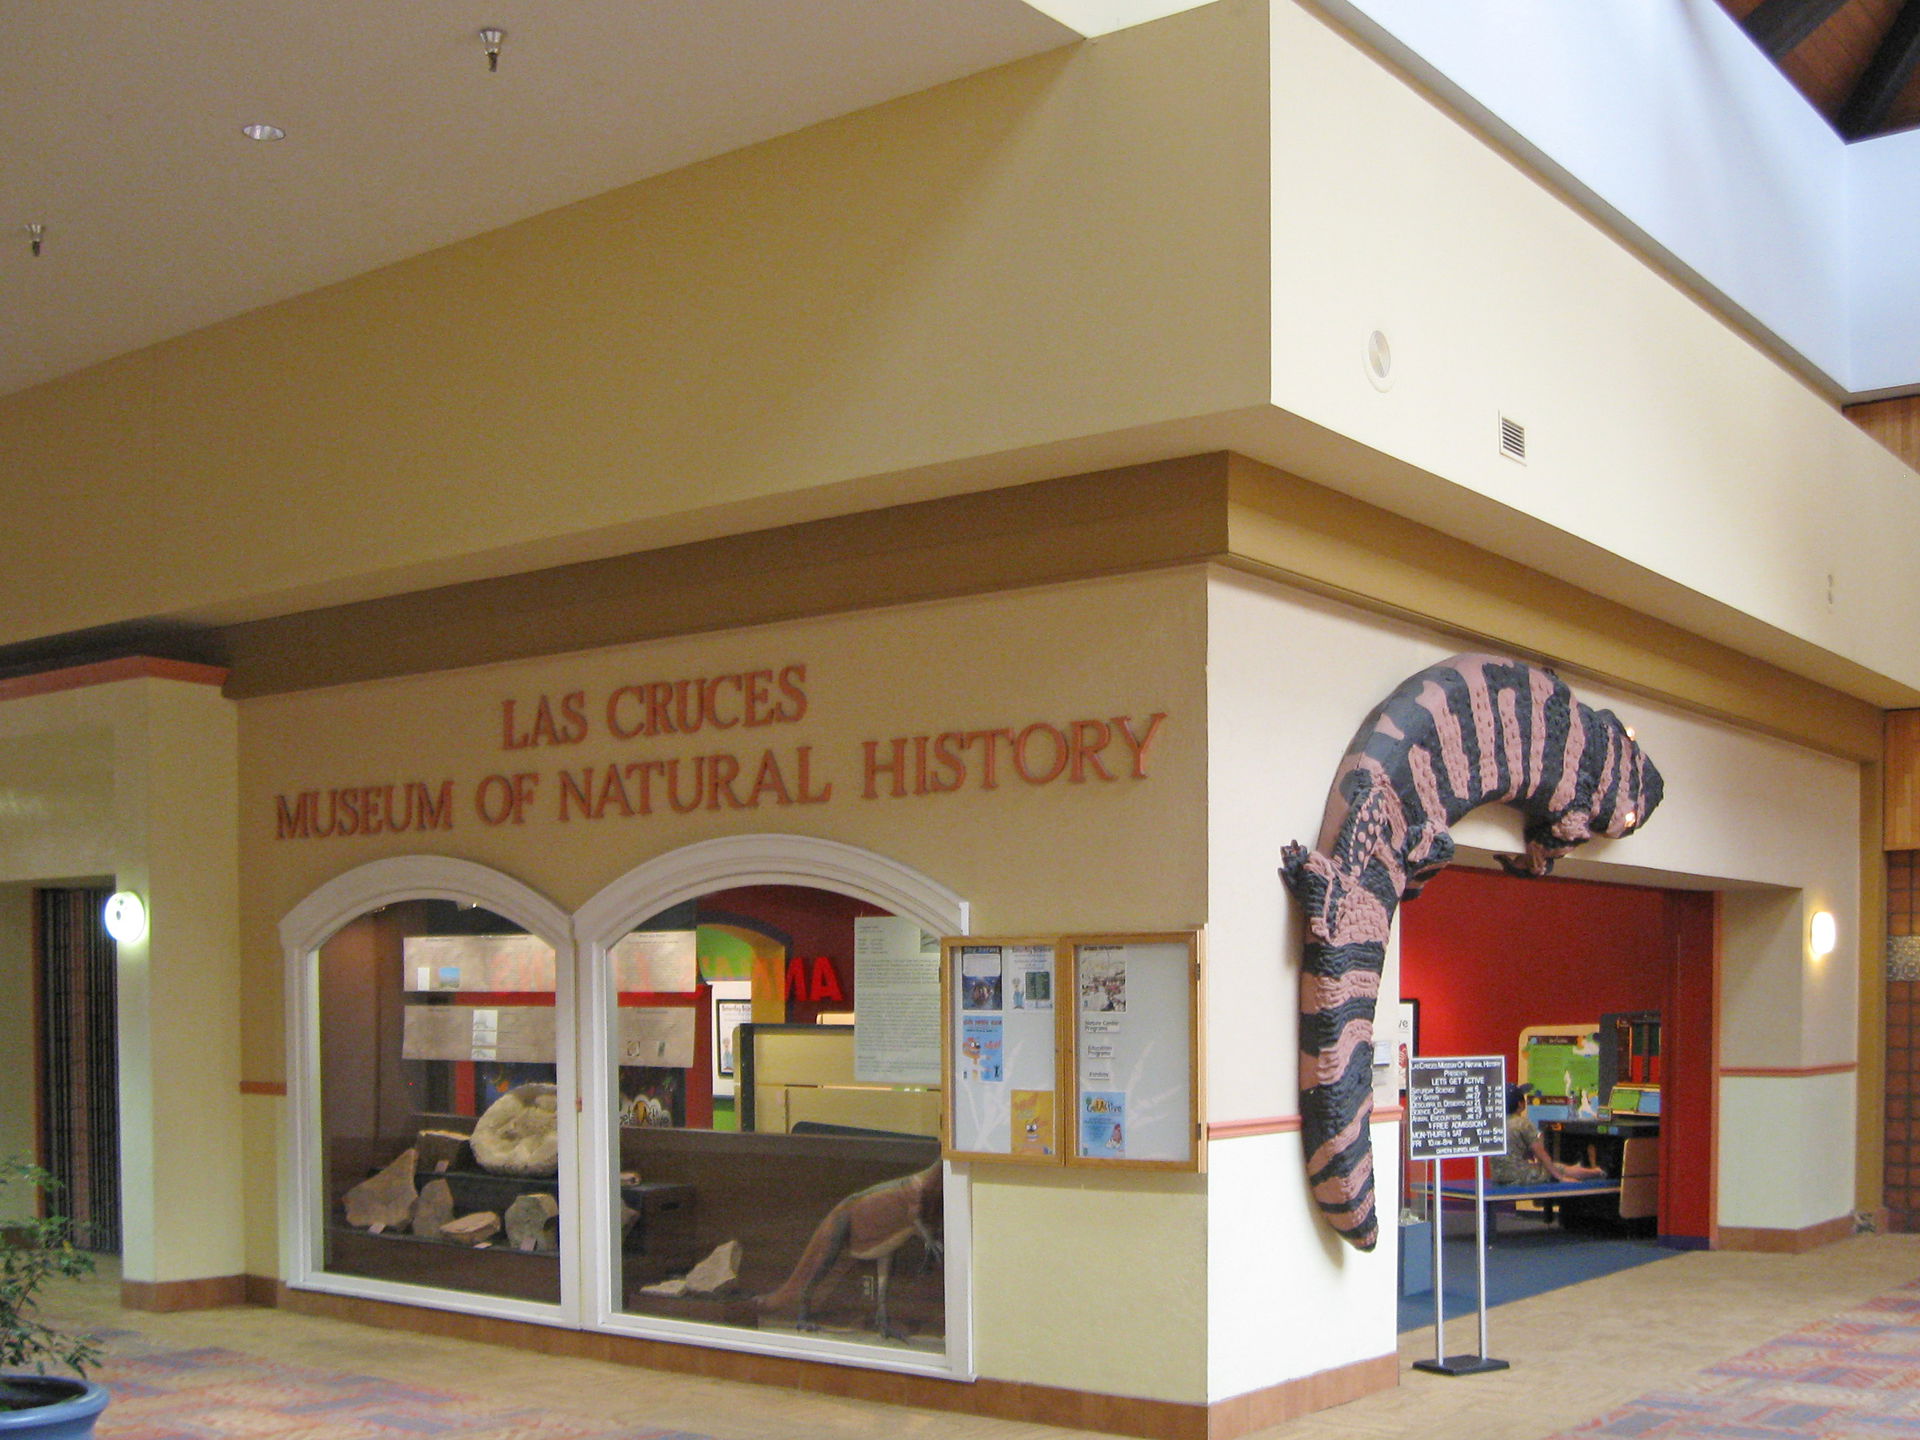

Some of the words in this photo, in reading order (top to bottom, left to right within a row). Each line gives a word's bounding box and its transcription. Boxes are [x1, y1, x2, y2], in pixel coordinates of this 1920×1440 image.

[501, 690, 588, 751] LAS
[605, 664, 809, 740] CRUCES
[274, 780, 455, 841] MUSEUM
[474, 772, 541, 827] OF
[557, 745, 834, 823] NATURAL
[860, 711, 1169, 800] HISTORY
[1449, 1077, 1461, 1086] GET
[1463, 1076, 1485, 1085] ACTIVE
[1452, 1129, 1462, 1137] SAT
[1458, 1137, 1471, 1145] SUN
